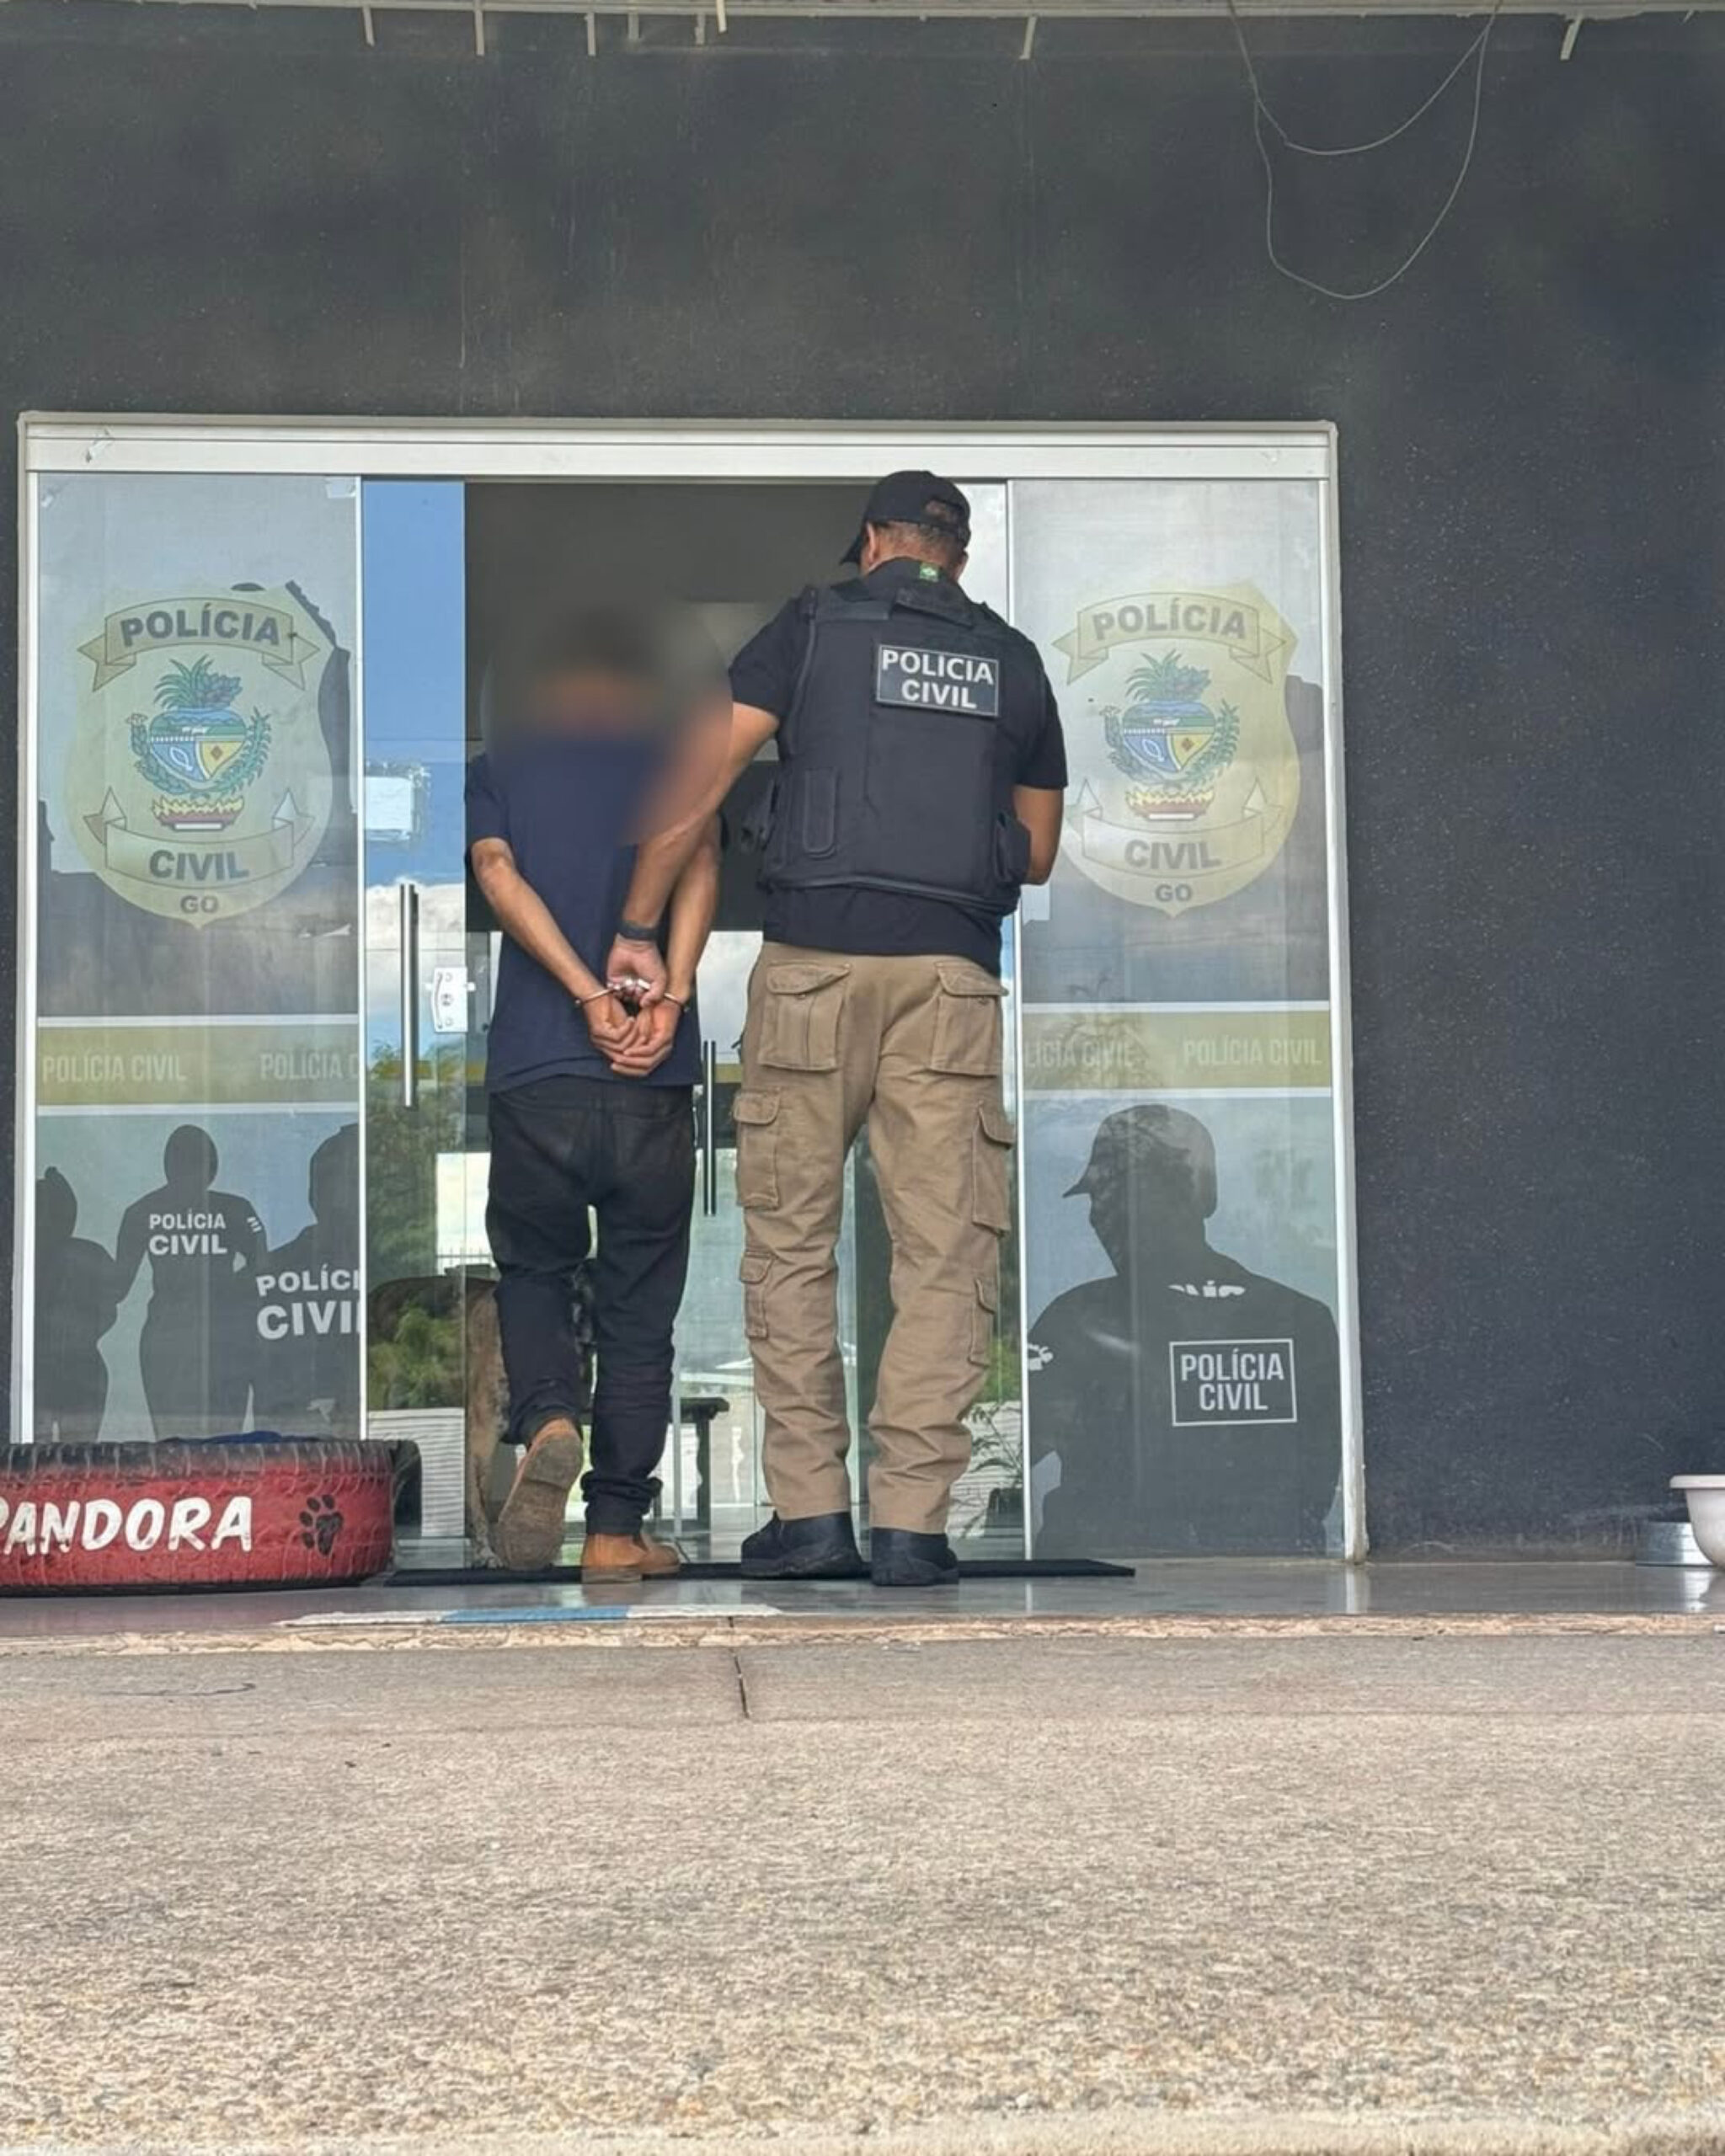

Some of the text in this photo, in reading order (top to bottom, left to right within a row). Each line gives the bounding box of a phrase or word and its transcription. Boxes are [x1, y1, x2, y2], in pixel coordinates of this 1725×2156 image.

[120, 602, 280, 647] POLÍCIA
[1092, 597, 1246, 641] POLÍCIA
[882, 649, 994, 685] POLICIA
[901, 679, 977, 709] CIVIL
[150, 850, 249, 881] CIVIL
[1124, 840, 1222, 870] CIVIL
[180, 894, 219, 914] GO
[1155, 884, 1193, 902] GO
[259, 1049, 344, 1081] POLÍCIA
[1081, 1038, 1135, 1070] CIVIL
[1184, 1034, 1323, 1065] POLÍCIA CIVIL
[42, 1049, 188, 1083] POLÍCIA CIVIL
[149, 1209, 227, 1230] POLÍCIA
[148, 1234, 227, 1256] CIVIL
[256, 1300, 360, 1340] CIVI
[1181, 1348, 1284, 1381] POLÍCIA
[1199, 1382, 1268, 1411] CIVIL
